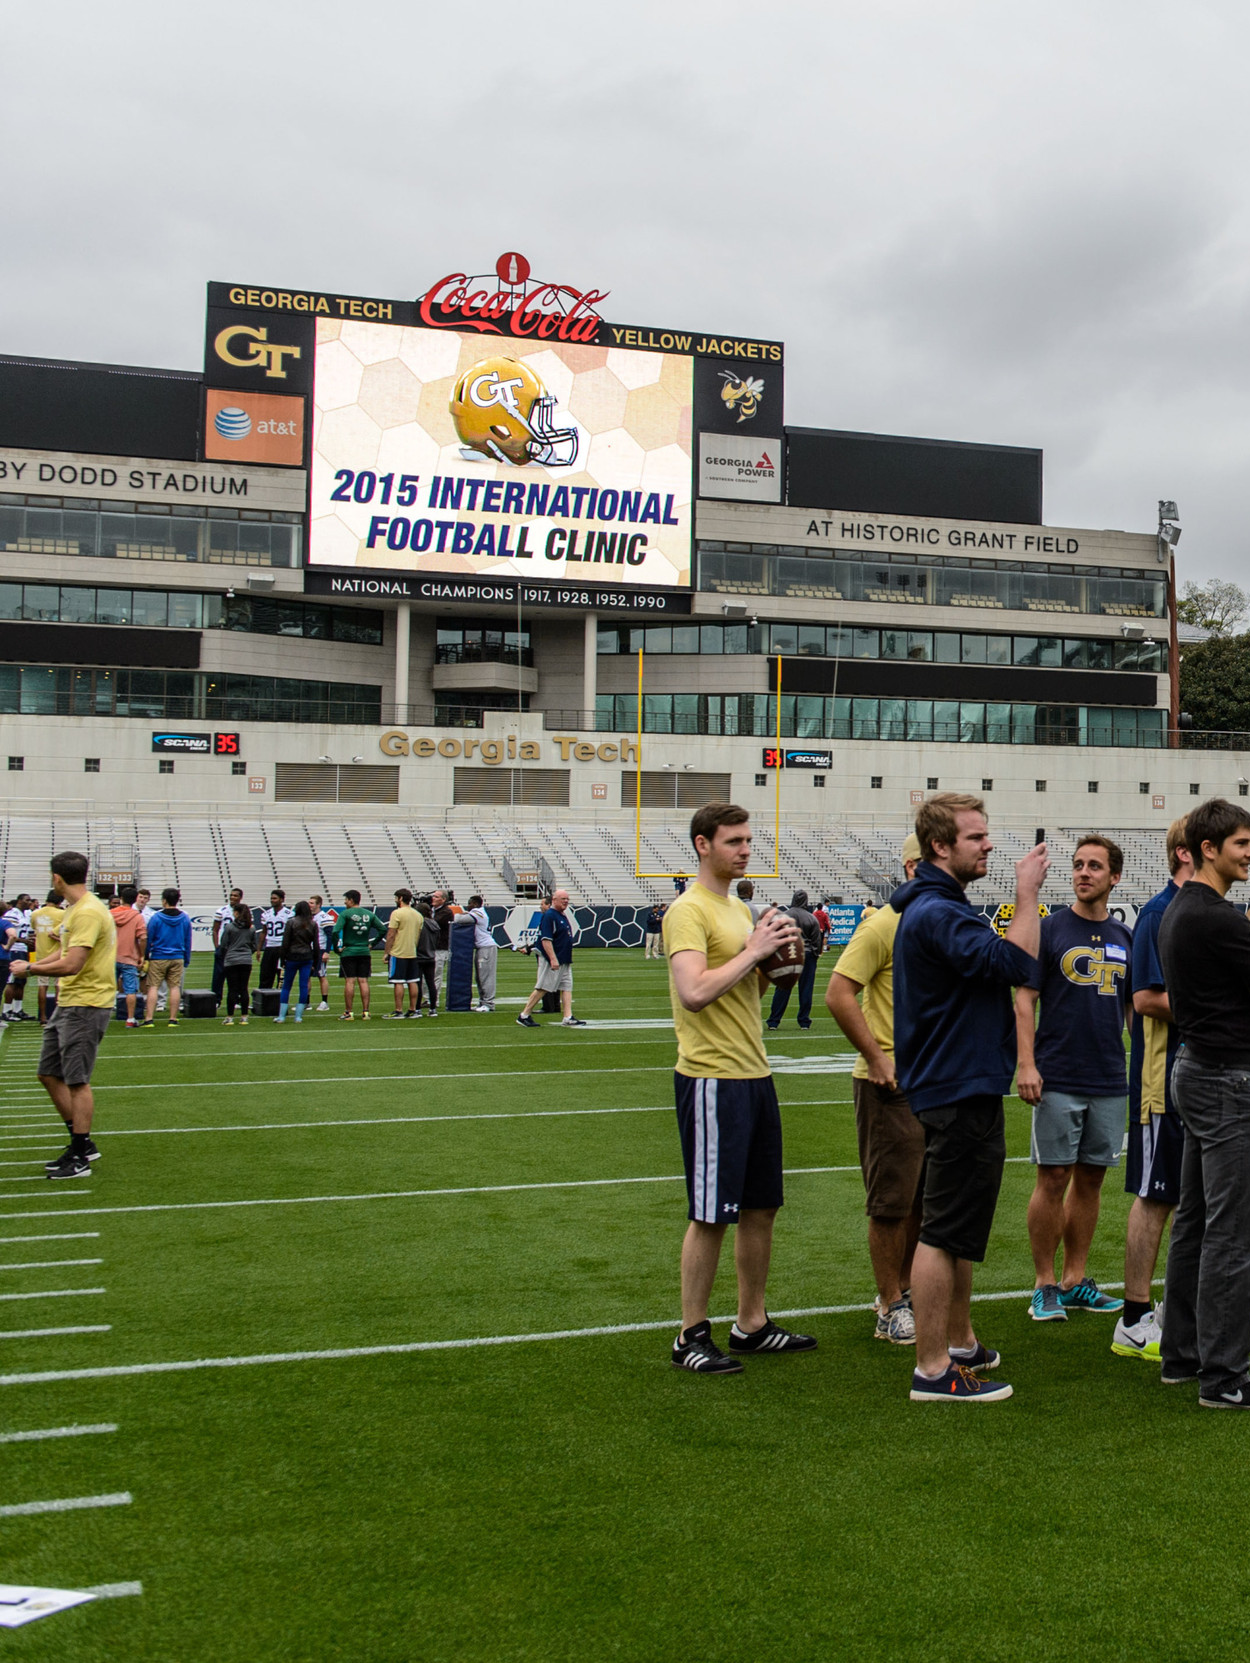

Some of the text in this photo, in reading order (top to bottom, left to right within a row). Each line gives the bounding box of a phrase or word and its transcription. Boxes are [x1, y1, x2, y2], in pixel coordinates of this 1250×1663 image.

[229, 287, 392, 320] GEORGIA TECH
[420, 272, 611, 343] Coca-Cola
[214, 325, 300, 379] GT
[612, 327, 782, 361] YELLOW JACKETS
[469, 371, 524, 408] GT
[257, 418, 297, 436] at&t
[705, 456, 753, 468] GEORGIA
[737, 468, 775, 478] POWER
[39, 463, 118, 487] DODD
[129, 470, 249, 496] STADIUM
[330, 468, 680, 526] 2015 INTERNATIONAL
[365, 515, 650, 567] FOOTBALL CLINIC
[807, 520, 1080, 554] AT HISTORIC GRANT FIELD
[331, 578, 411, 596] NATIONAL
[420, 582, 515, 601] CHAMPIONS
[633, 596, 667, 610] 1990
[217, 735, 237, 752] 35
[380, 730, 641, 766] Georgia Tech
[830, 907, 855, 916] Atlanta
[830, 926, 854, 935] Center
[1060, 946, 1127, 995] GT
